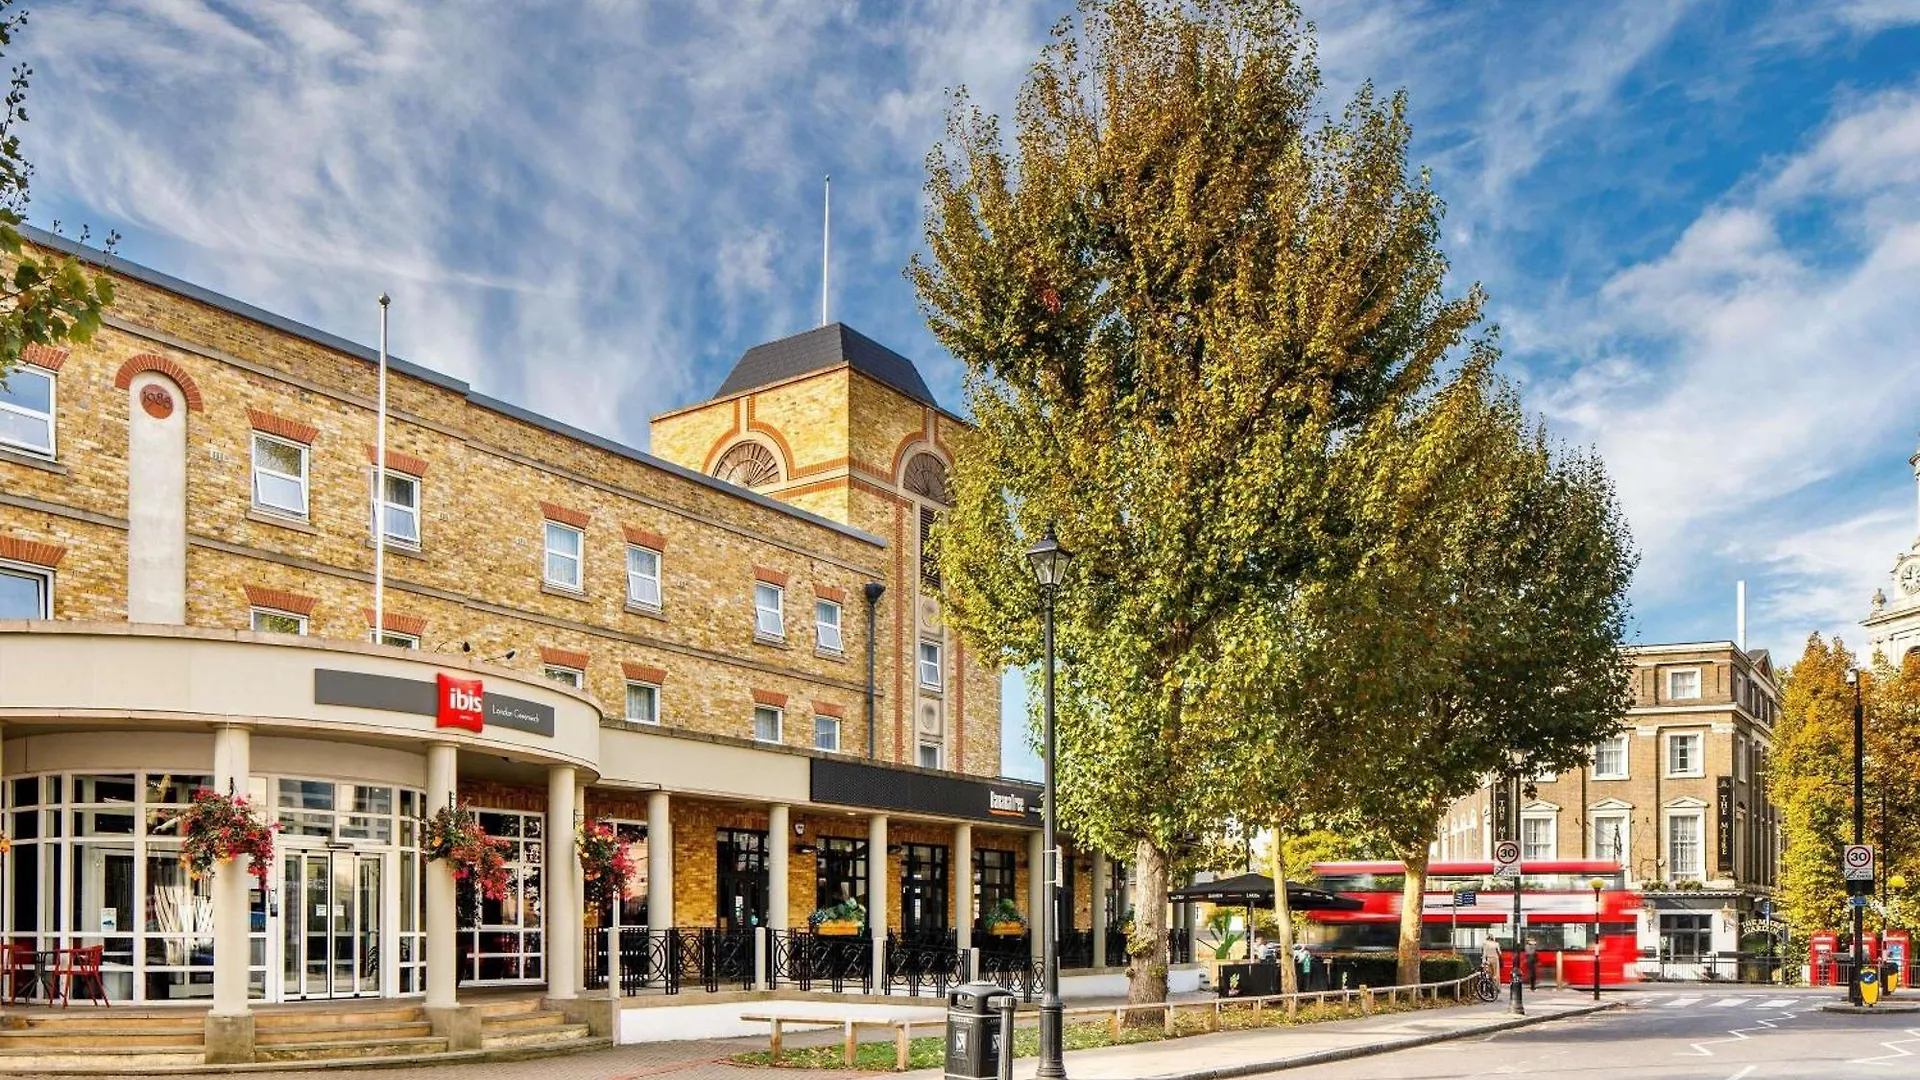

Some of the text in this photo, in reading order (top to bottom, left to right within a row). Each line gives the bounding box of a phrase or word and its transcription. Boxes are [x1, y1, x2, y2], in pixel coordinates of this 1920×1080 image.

[449, 687, 483, 712] ibis
[1500, 848, 1516, 858] 30
[1850, 852, 1867, 861] 30
